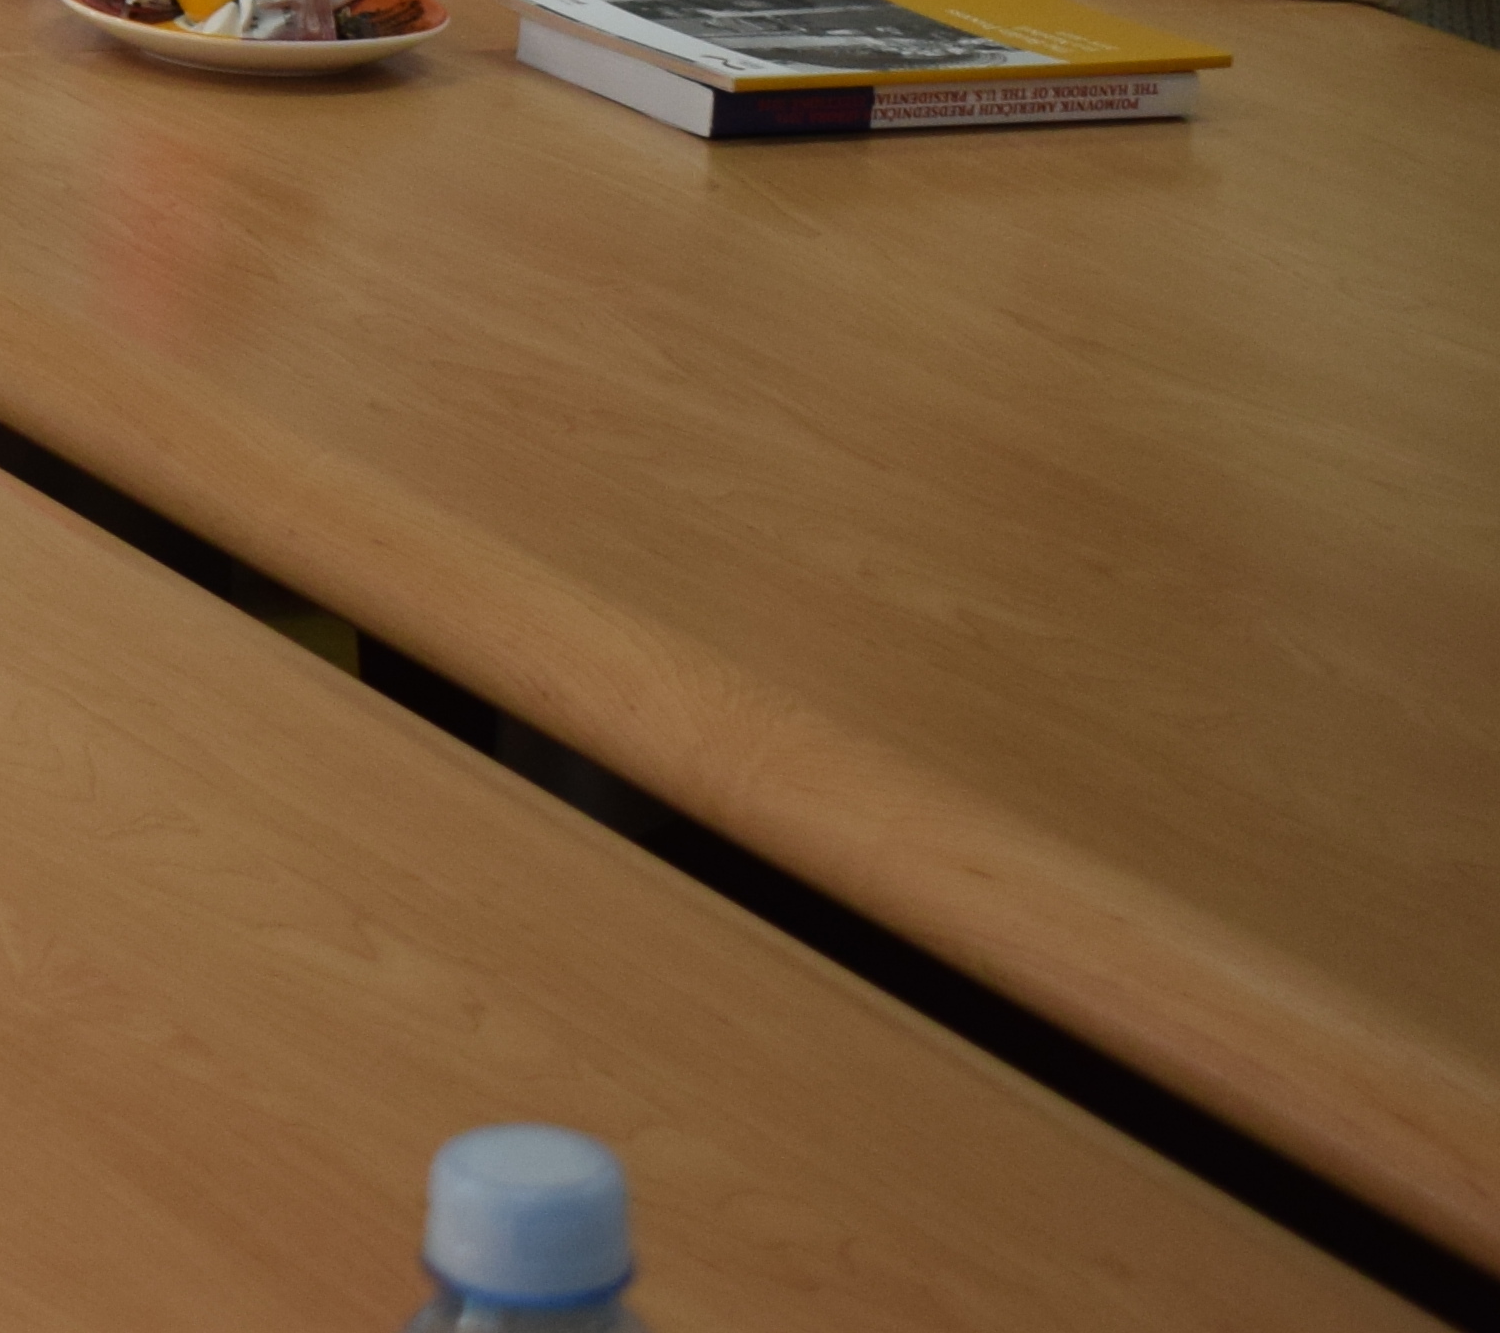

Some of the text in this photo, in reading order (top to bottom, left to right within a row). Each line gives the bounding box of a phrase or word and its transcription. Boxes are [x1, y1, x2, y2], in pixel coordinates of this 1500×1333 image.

[972, 89, 997, 103] U.S.
[1000, 88, 1027, 101] THE
[1029, 87, 1049, 100] OF
[1050, 84, 1129, 99] HANDBOOK
[1132, 83, 1159, 96] THE
[979, 100, 1058, 118] AMERIČKIH
[1060, 97, 1140, 113] POJMOVNIK
